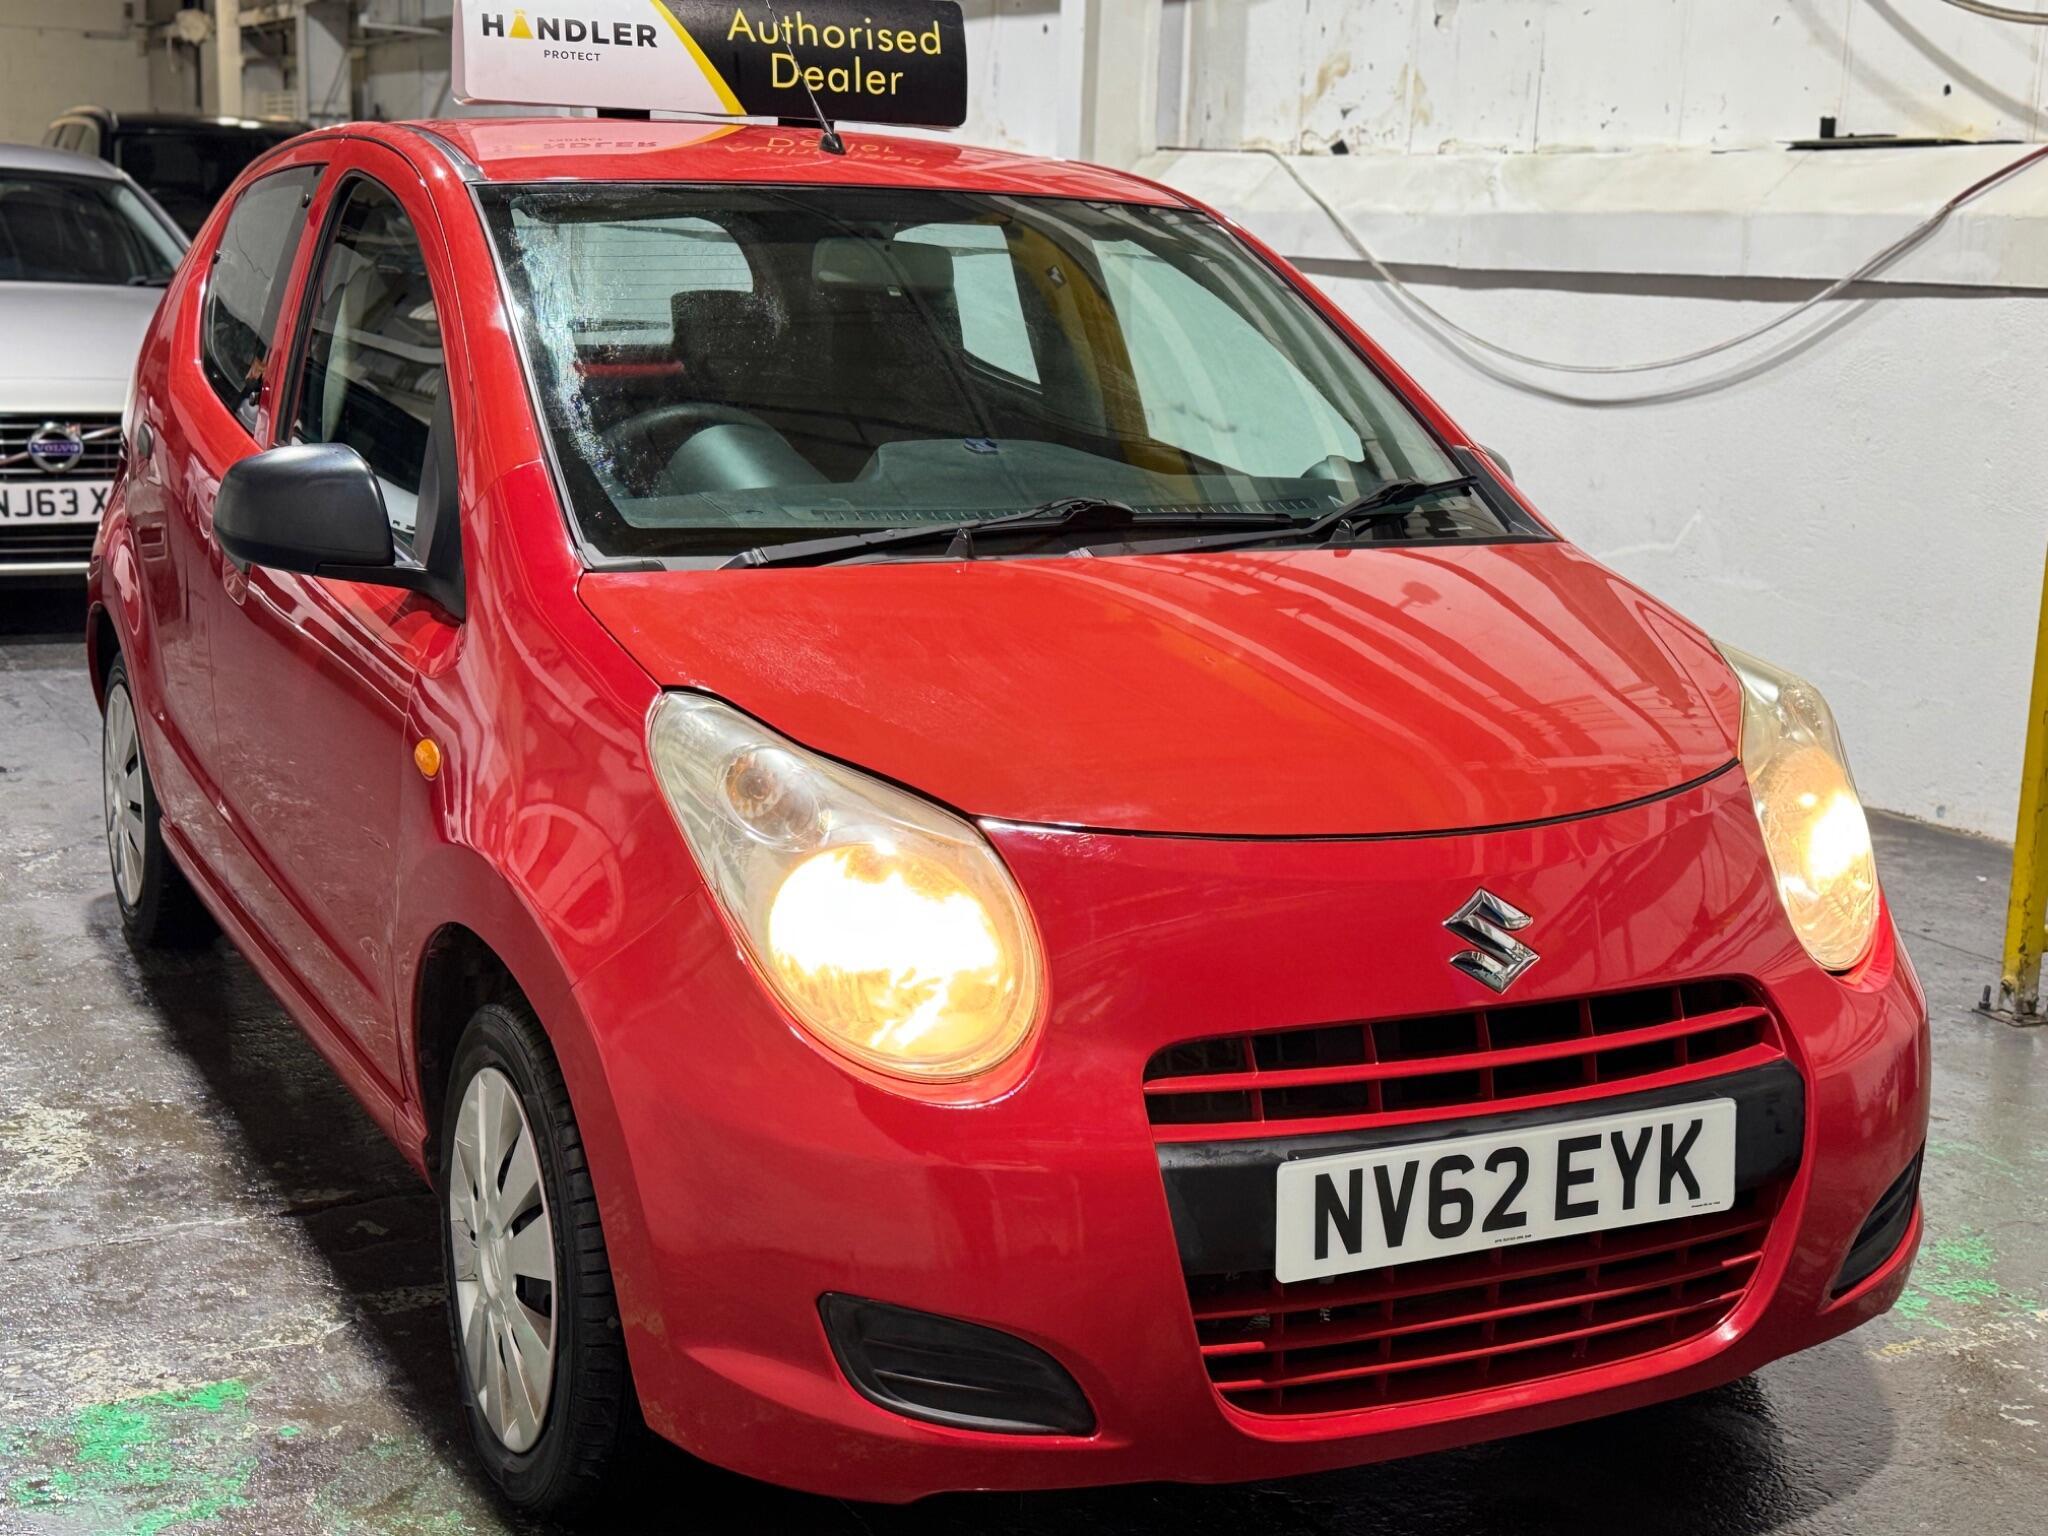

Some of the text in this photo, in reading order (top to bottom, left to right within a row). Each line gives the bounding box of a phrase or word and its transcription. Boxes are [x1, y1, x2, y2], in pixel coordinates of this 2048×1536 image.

[726, 7, 942, 55] Authorised
[543, 49, 601, 62] PROTECT
[770, 52, 904, 96] Dealer
[1313, 1118, 1704, 1261] NV62 EYK
